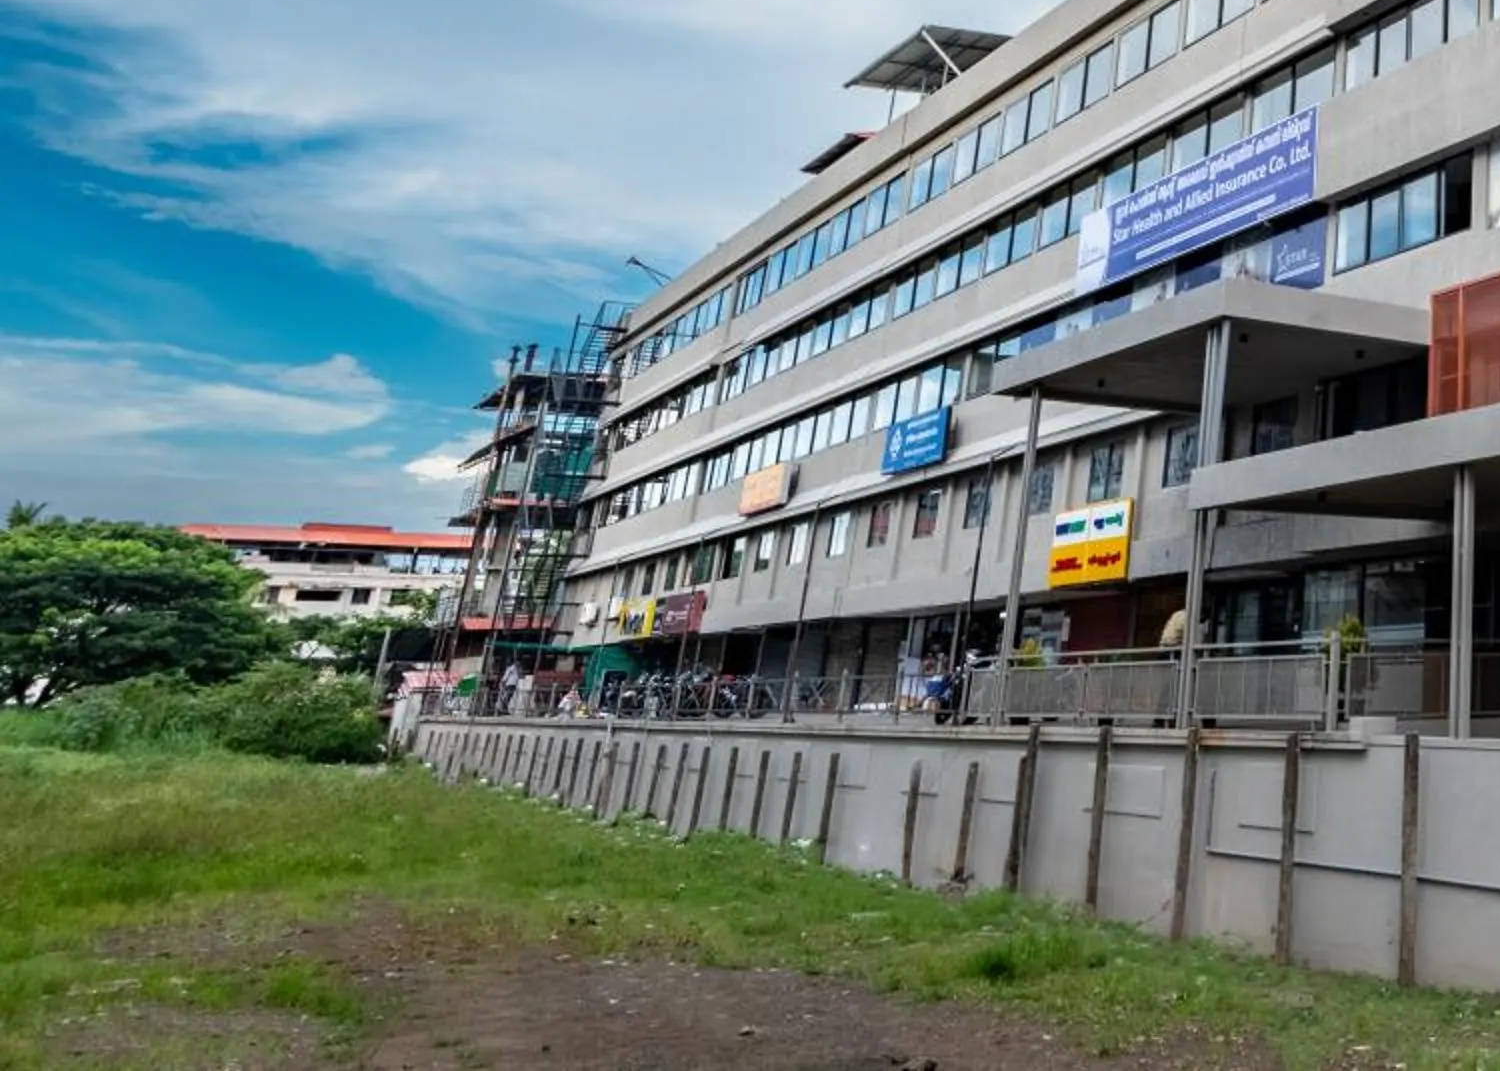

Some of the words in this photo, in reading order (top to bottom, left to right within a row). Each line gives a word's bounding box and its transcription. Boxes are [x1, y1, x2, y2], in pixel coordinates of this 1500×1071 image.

[1132, 210, 1163, 235] Health
[1165, 200, 1183, 220] and
[1184, 184, 1213, 211] Allied
[1215, 163, 1267, 198] Insurance
[1269, 155, 1287, 174] Co.
[1289, 140, 1312, 165] Ltd.
